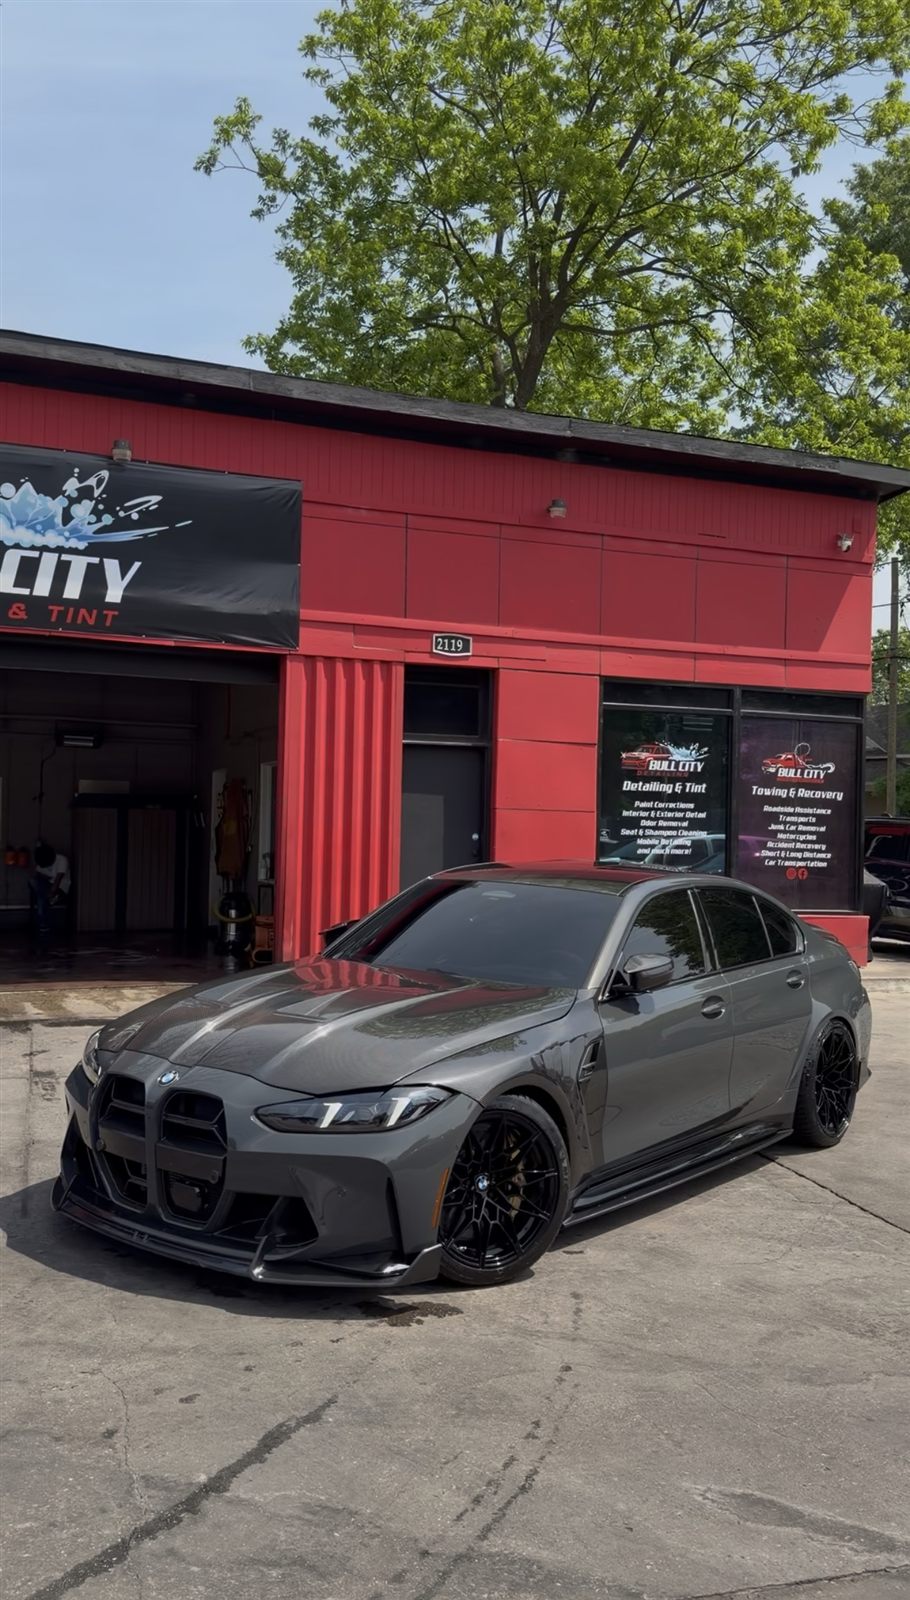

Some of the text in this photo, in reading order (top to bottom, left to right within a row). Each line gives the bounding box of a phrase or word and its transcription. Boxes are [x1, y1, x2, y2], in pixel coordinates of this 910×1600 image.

[0, 548, 142, 603] CITY
[8, 602, 118, 626] & TINT
[437, 638, 463, 651] 2119
[649, 760, 704, 772] BULL CITY
[778, 768, 826, 779] BULL CITY
[623, 781, 707, 793] Detailing & Tint
[752, 785, 843, 801] Towing & Recovery
[654, 801, 695, 809] Corrections
[796, 842, 826, 850] Recovery
